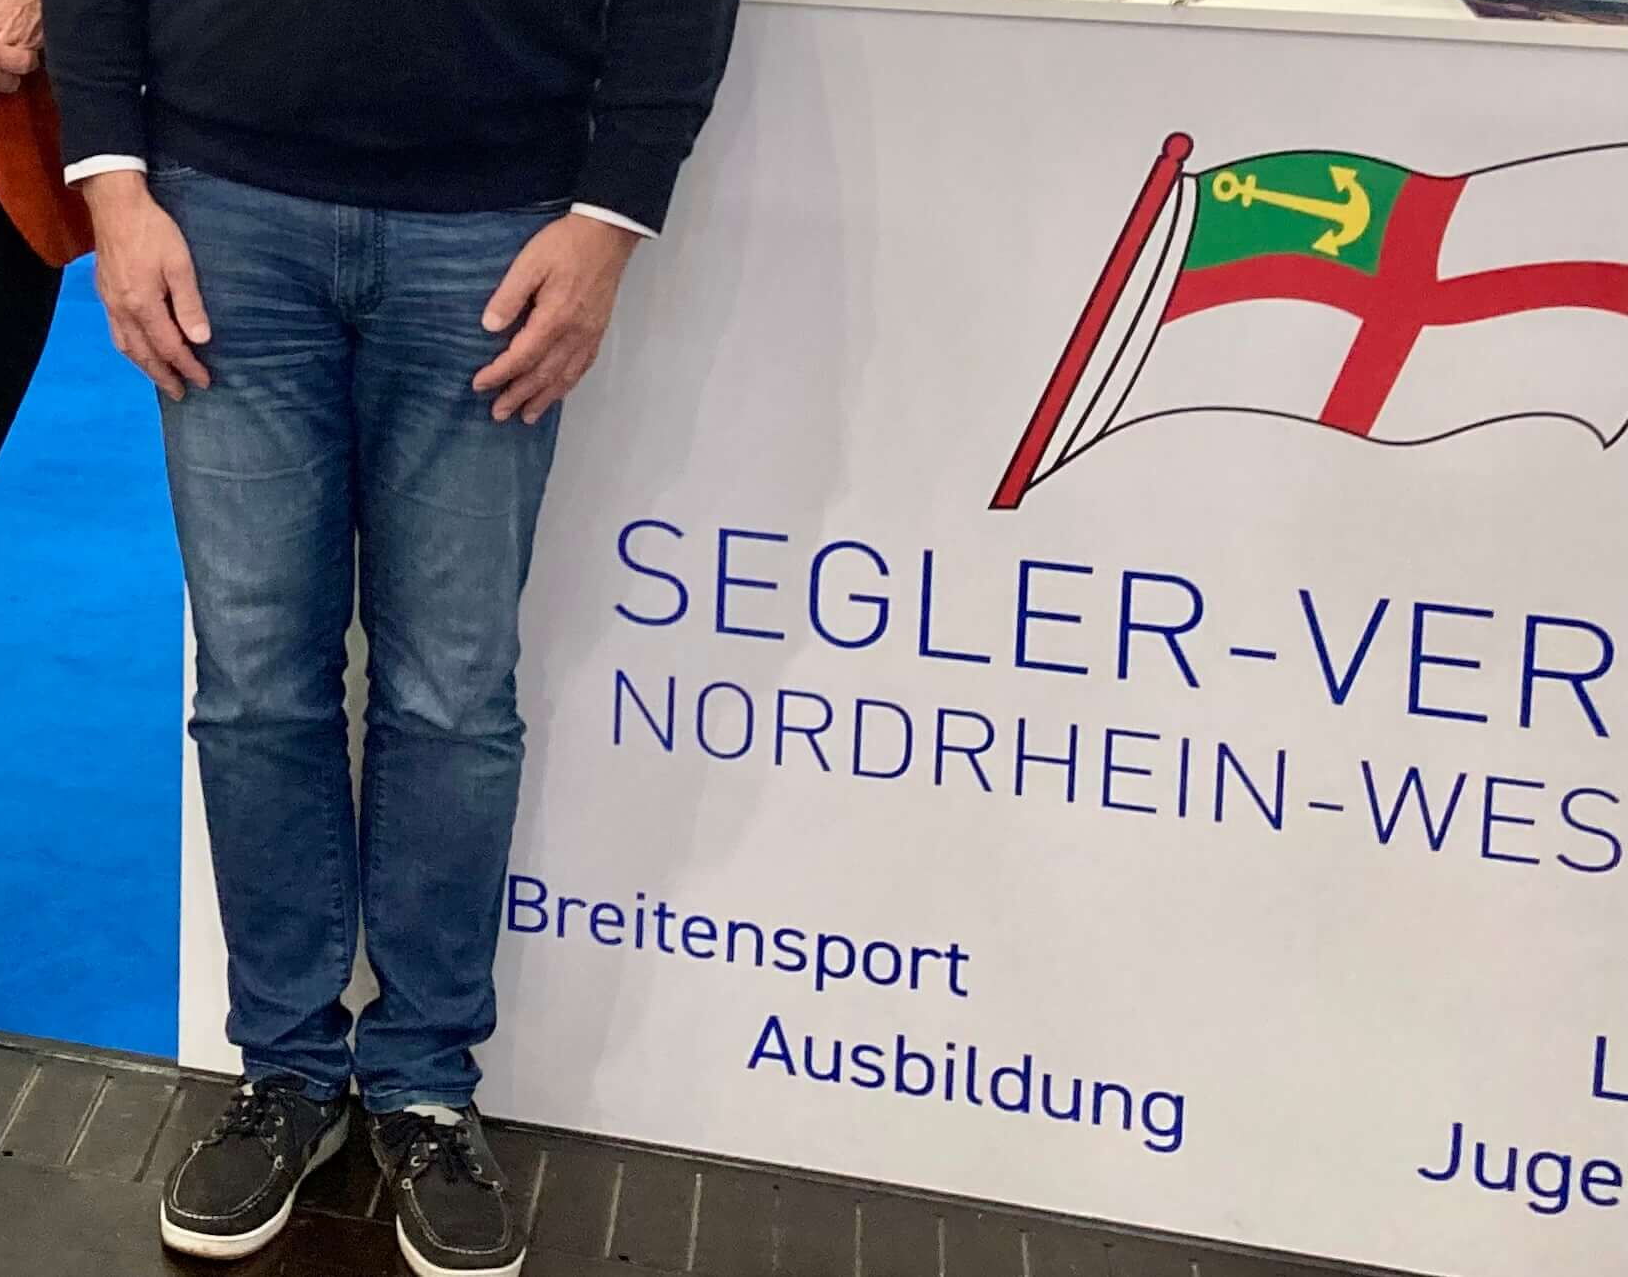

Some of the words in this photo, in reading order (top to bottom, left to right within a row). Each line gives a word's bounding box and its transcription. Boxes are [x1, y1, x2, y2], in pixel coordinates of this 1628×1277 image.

[615, 519, 1615, 738] SEGLER-VER
[612, 670, 1623, 873] NORDRHEIN-WES
[507, 874, 970, 997] Breitensport
[747, 1015, 1186, 1153] Ausbildung
[1417, 1122, 1623, 1214] Juge
